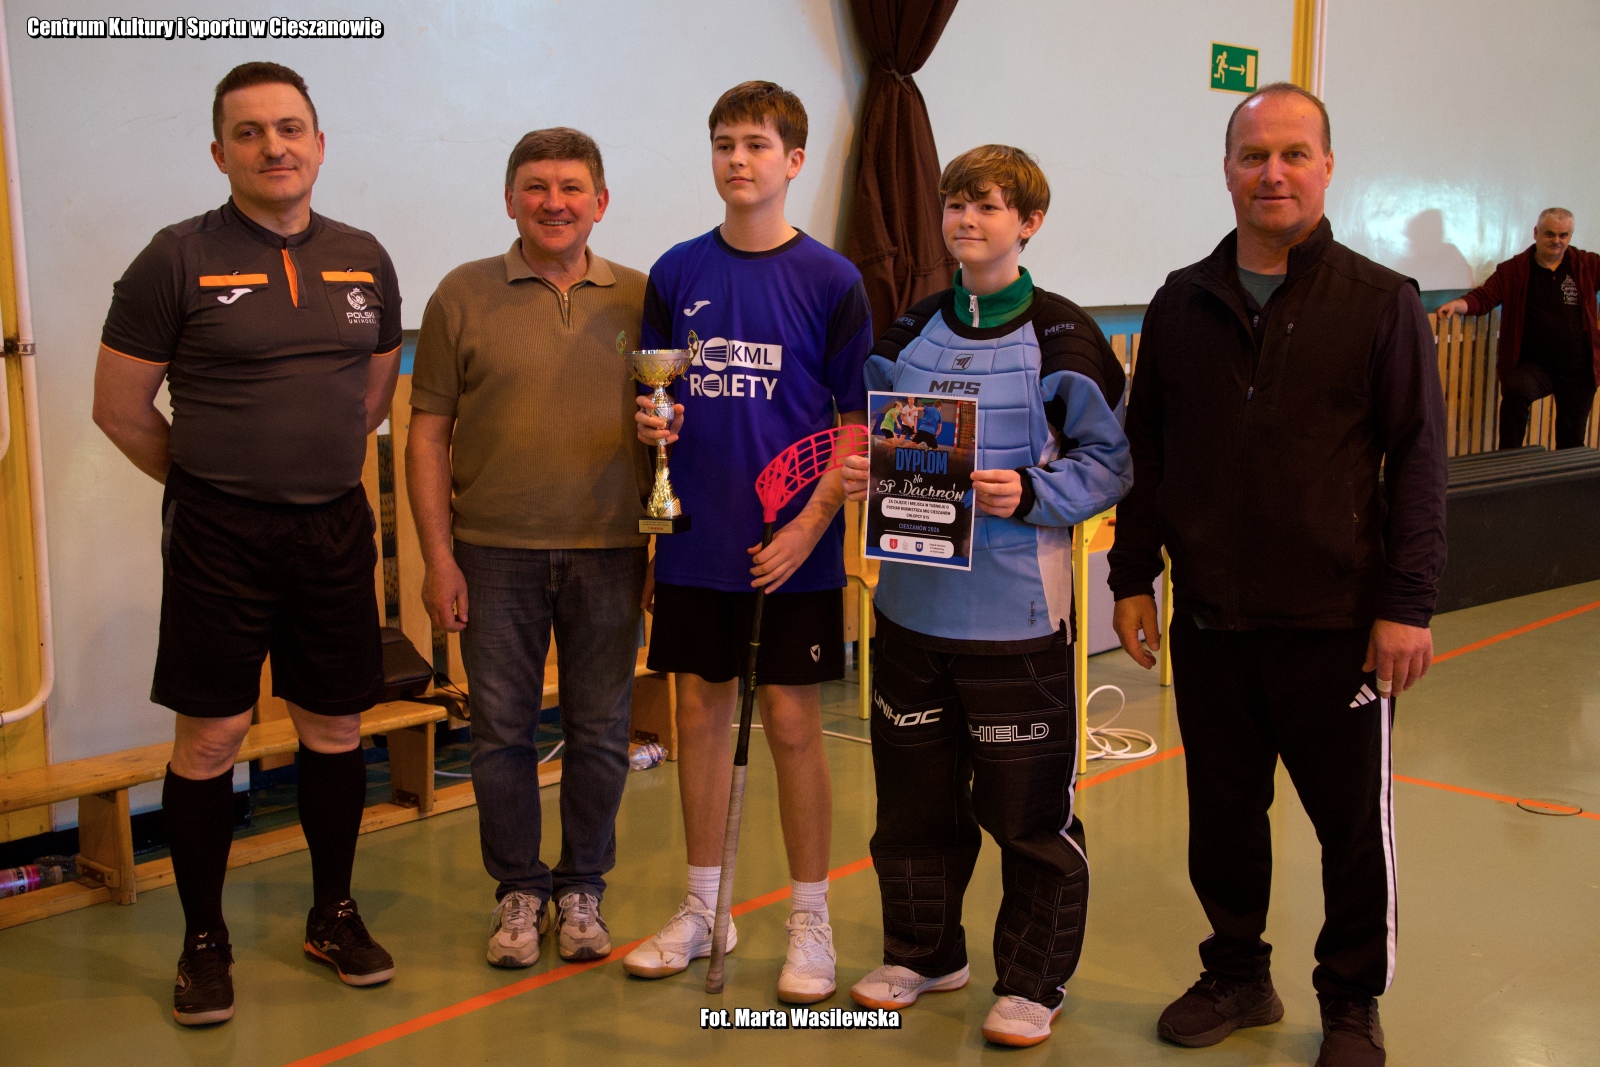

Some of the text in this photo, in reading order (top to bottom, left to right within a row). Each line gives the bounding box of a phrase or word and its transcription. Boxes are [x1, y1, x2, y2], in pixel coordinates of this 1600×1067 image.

[1044, 323, 1075, 336] MPS
[731, 344, 773, 365] KML
[689, 373, 778, 400] ROLETY
[928, 380, 981, 395] MPS
[895, 447, 948, 475] DYPLOM
[876, 478, 965, 501] SP Dachnów
[898, 523, 927, 532] CIESZANÓW
[874, 689, 944, 727] UNIHOC
[967, 721, 1050, 743] HIELD
